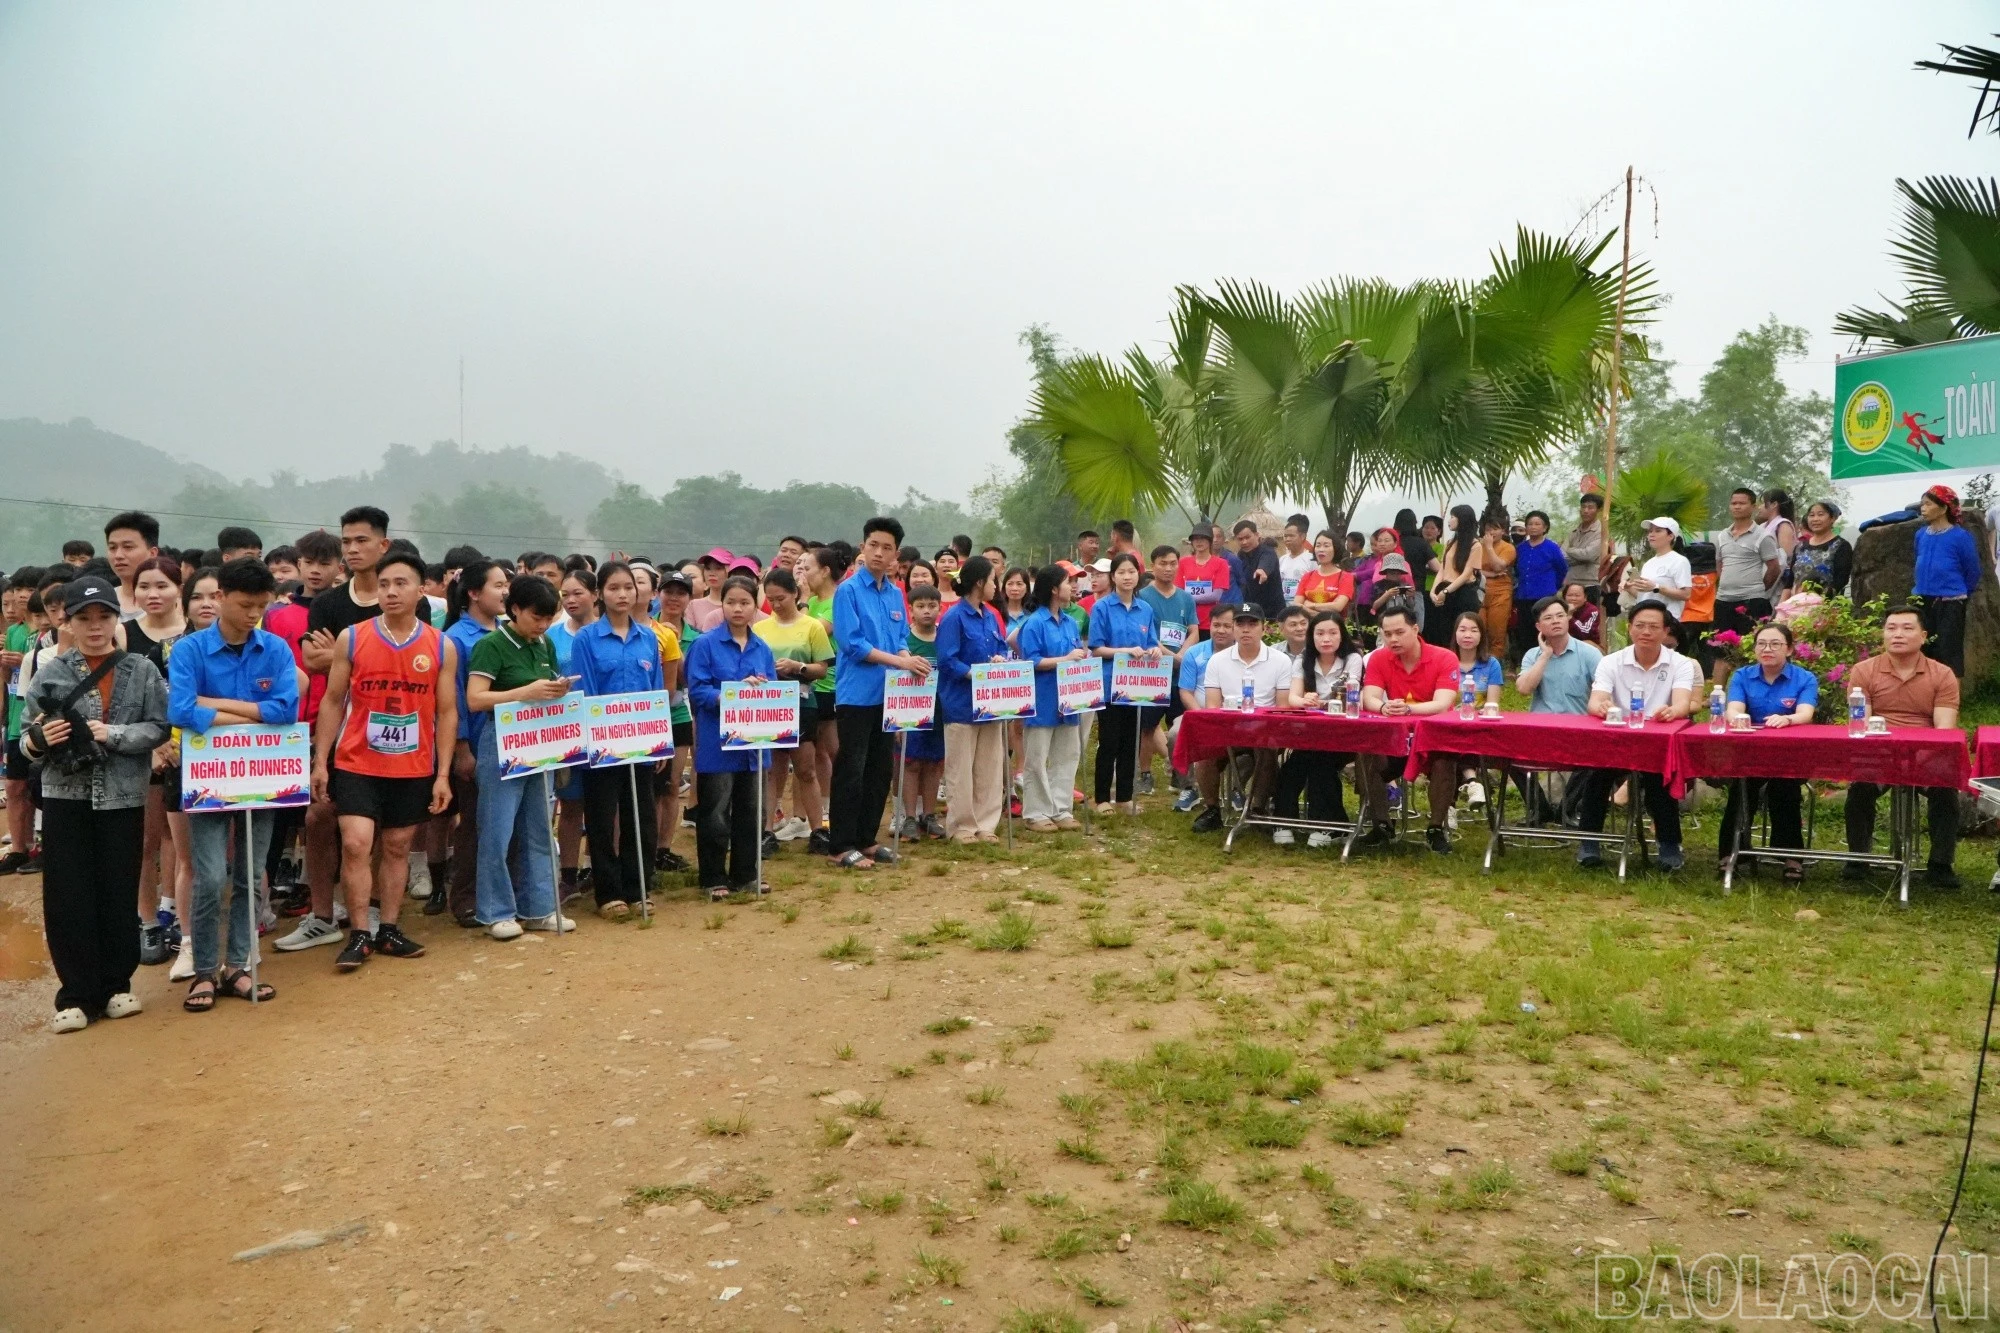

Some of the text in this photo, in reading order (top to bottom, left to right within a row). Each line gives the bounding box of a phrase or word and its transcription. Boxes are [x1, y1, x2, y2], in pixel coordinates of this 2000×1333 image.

[1944, 371, 1996, 439] TOÀN
[1190, 587, 1205, 595] 324
[1168, 629, 1181, 640] 429
[986, 669, 1021, 680] ĐOÀN VĐV
[1115, 673, 1168, 688] LÀO CAI RUNNERS
[360, 680, 429, 694] STAR SPORTS
[739, 688, 781, 699] ĐOÀN VĐV
[976, 684, 1032, 701] BẮC HÀ RUNNERS
[516, 703, 565, 722] ĐOÀN VĐV
[605, 701, 650, 715] ĐOÀN VĐV
[724, 706, 794, 726] HÀ NỘI RUNNERS
[381, 725, 406, 742] 441
[502, 722, 582, 751] VPBANK RUNNERS
[590, 719, 669, 742] THÁI NGUYÊN RUNNERS
[212, 733, 281, 748] ĐOÀN VĐV
[190, 756, 303, 780] NGHĨA ĐÔ RUNNERS
